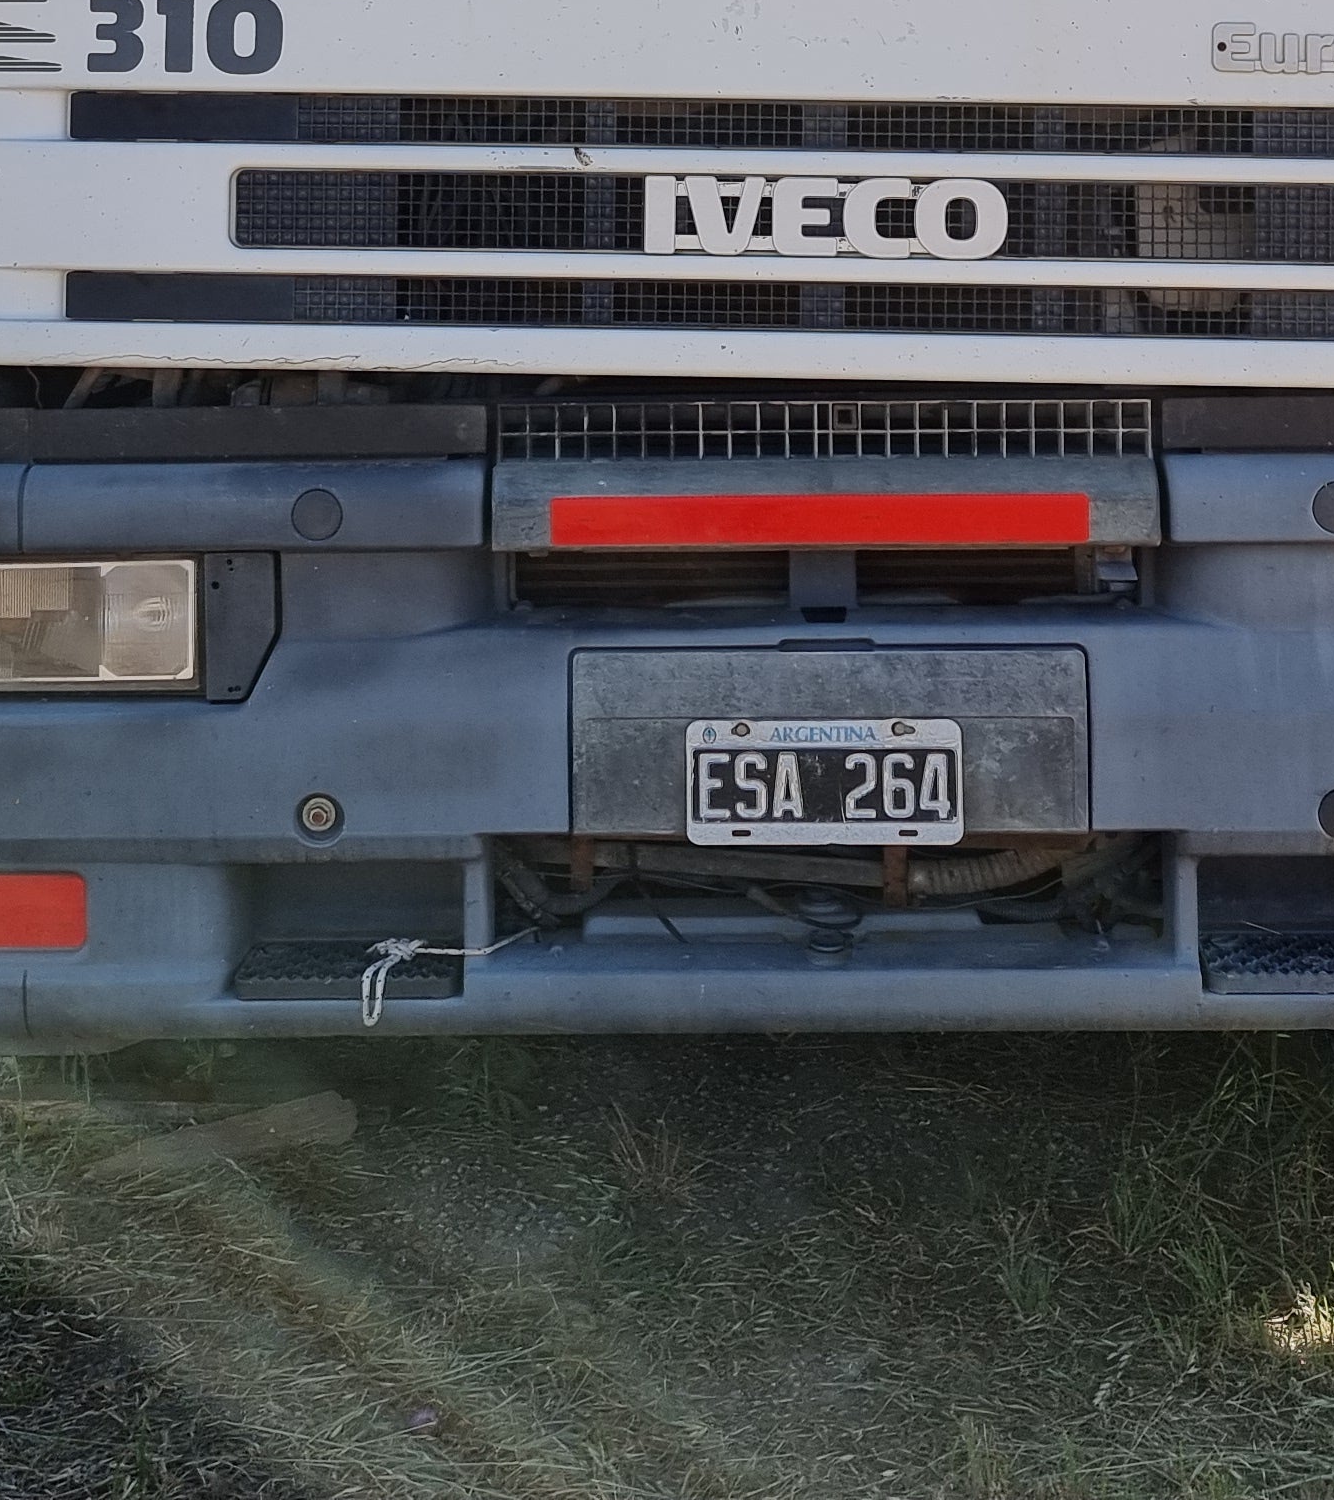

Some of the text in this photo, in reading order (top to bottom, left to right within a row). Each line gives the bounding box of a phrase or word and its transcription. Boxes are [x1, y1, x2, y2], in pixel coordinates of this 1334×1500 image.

[643, 177, 1008, 260] IVECO
[770, 723, 877, 745] ARGENTINA
[698, 751, 951, 820] ESA 264
